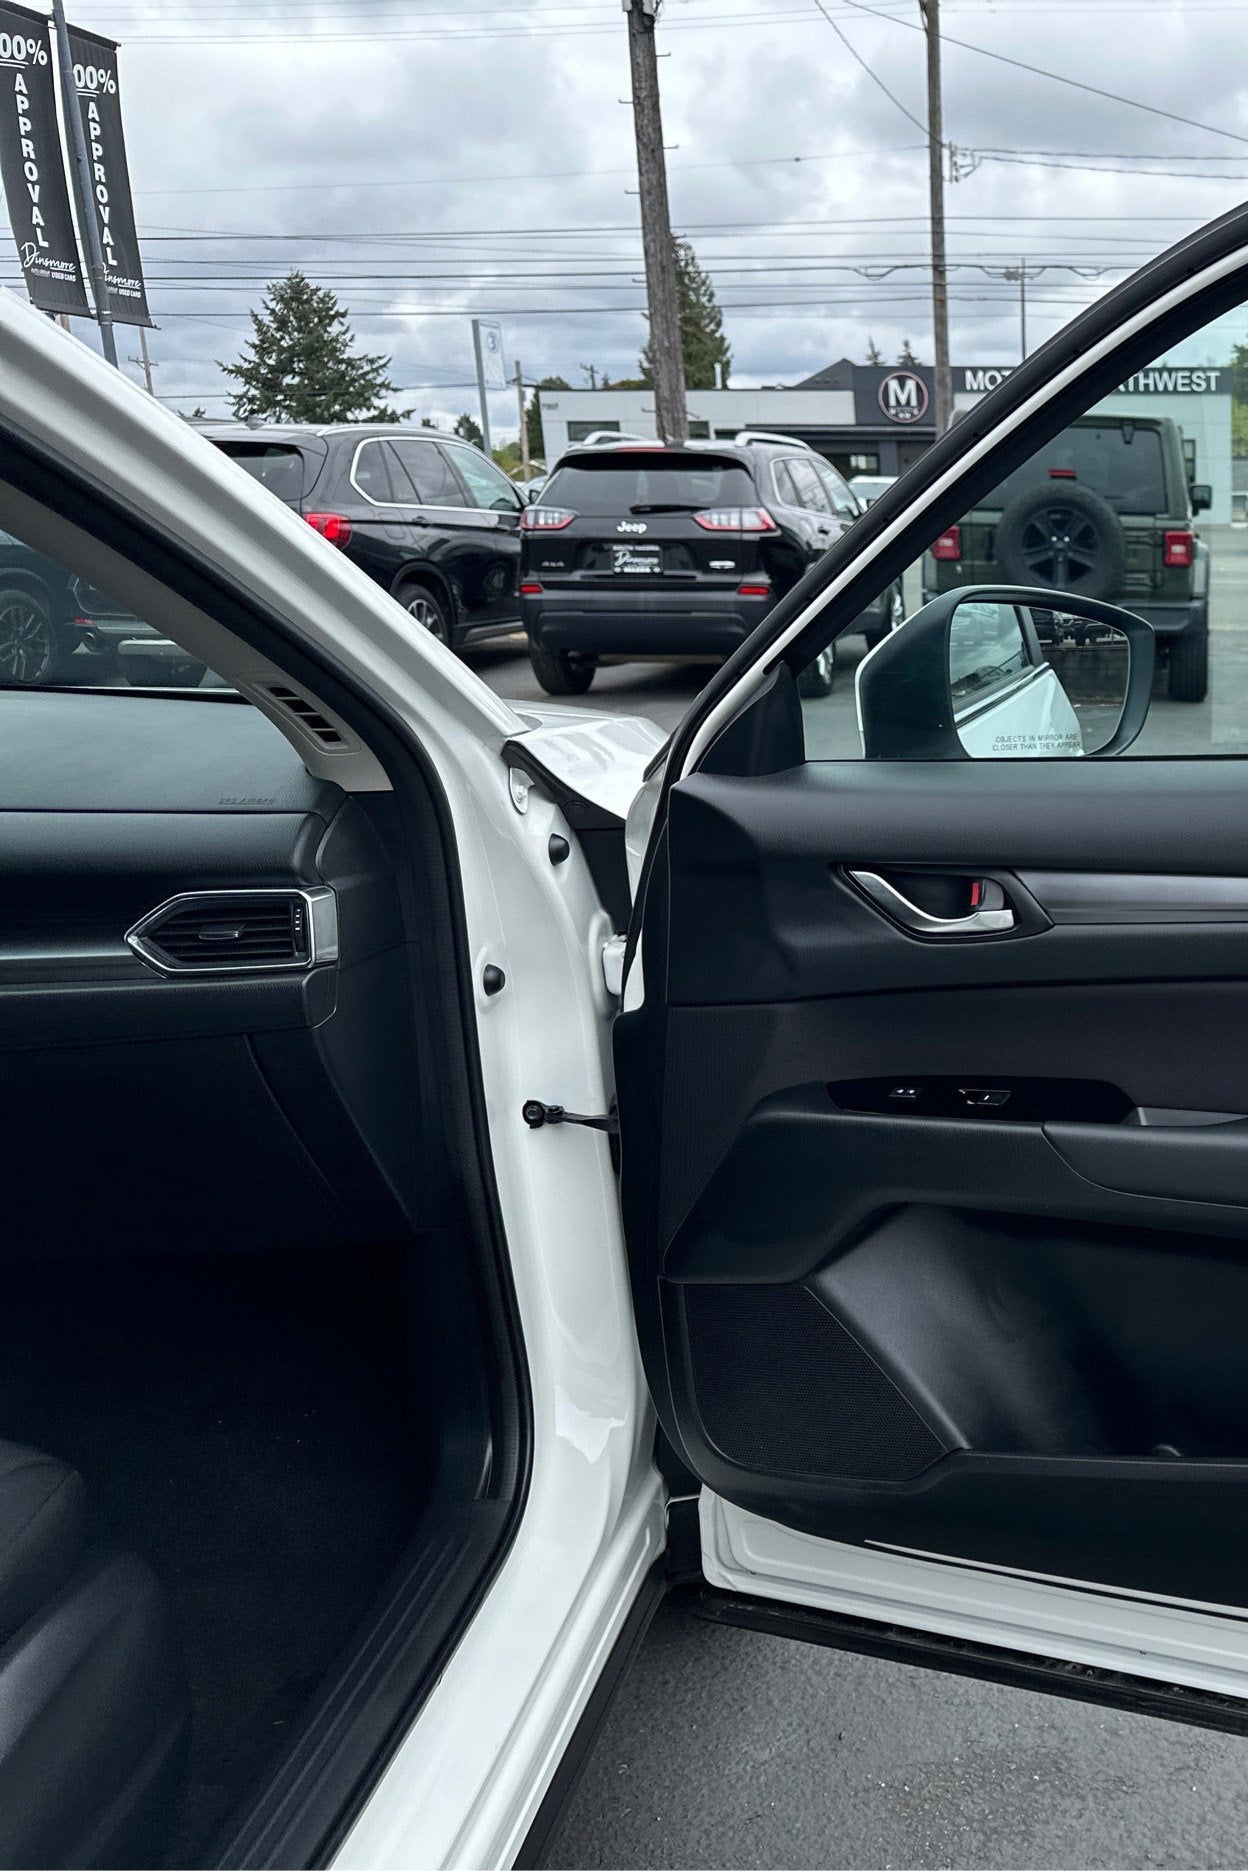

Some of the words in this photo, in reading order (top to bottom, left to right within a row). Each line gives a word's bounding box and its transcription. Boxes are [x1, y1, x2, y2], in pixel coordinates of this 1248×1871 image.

[0, 32, 48, 66] 00%
[73, 63, 117, 94] 00%
[14, 72, 50, 248] APPROVAL
[86, 101, 118, 267] APPROVAL
[21, 241, 76, 271] Dinsmore
[101, 262, 142, 288] insmore
[887, 378, 919, 407] M
[1116, 370, 1222, 393] THWEST
[616, 520, 648, 534] Jeep
[992, 743, 1018, 752] CLOSER
[1040, 742, 1054, 750] THEY
[1056, 741, 1081, 749] APPEAR
[995, 735, 1027, 744] OBJECTS
[1028, 734, 1036, 742] IN
[1037, 733, 1063, 742] MIRROR
[1065, 733, 1078, 741] ARE
